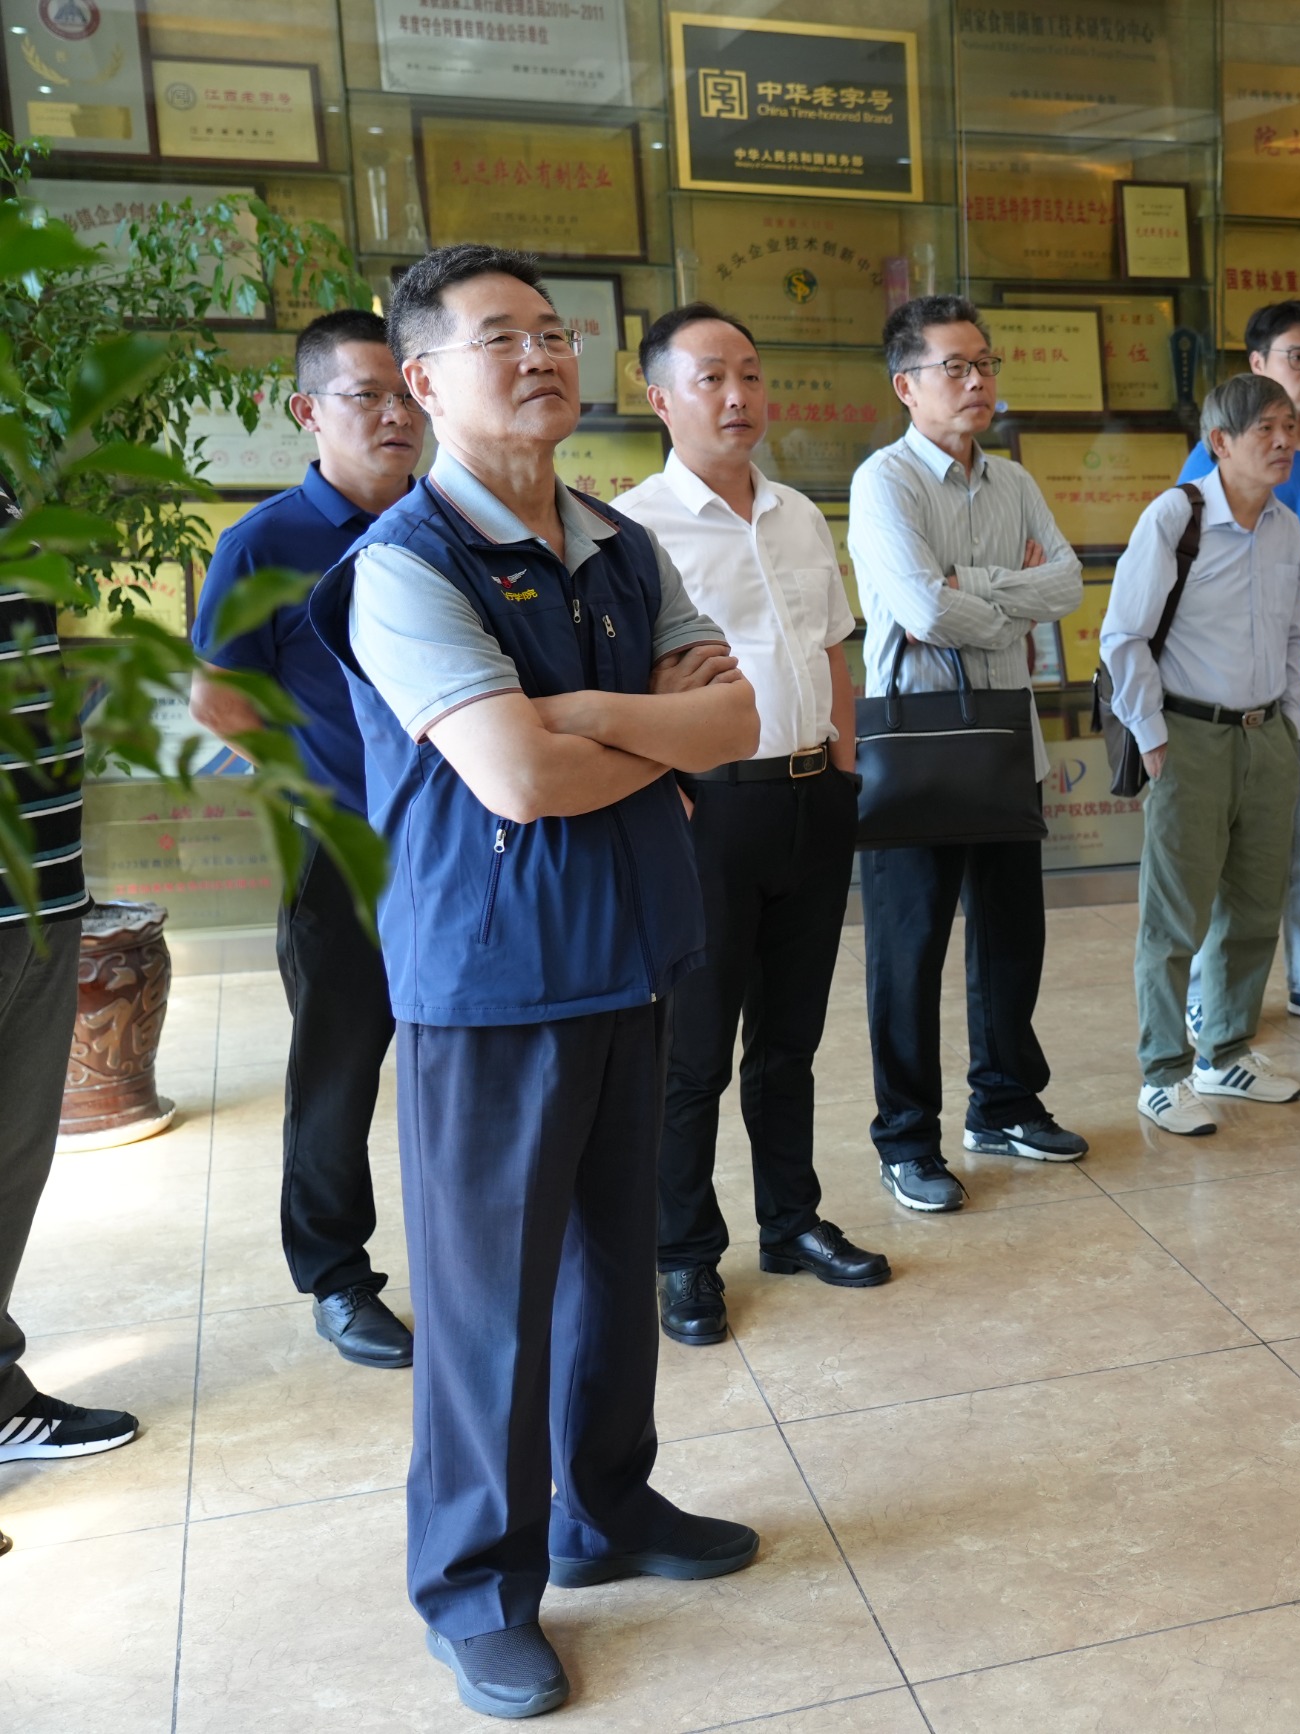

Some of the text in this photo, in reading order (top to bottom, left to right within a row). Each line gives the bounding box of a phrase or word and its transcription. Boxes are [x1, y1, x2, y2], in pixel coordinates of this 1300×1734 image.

[204, 89, 292, 106] 江西老字号
[757, 81, 893, 111] 中华老字号
[757, 103, 893, 124] China Time-honored Brand
[734, 147, 864, 168] 中华人民共和国商务部
[716, 236, 884, 291] 龙头企业技术创新中心
